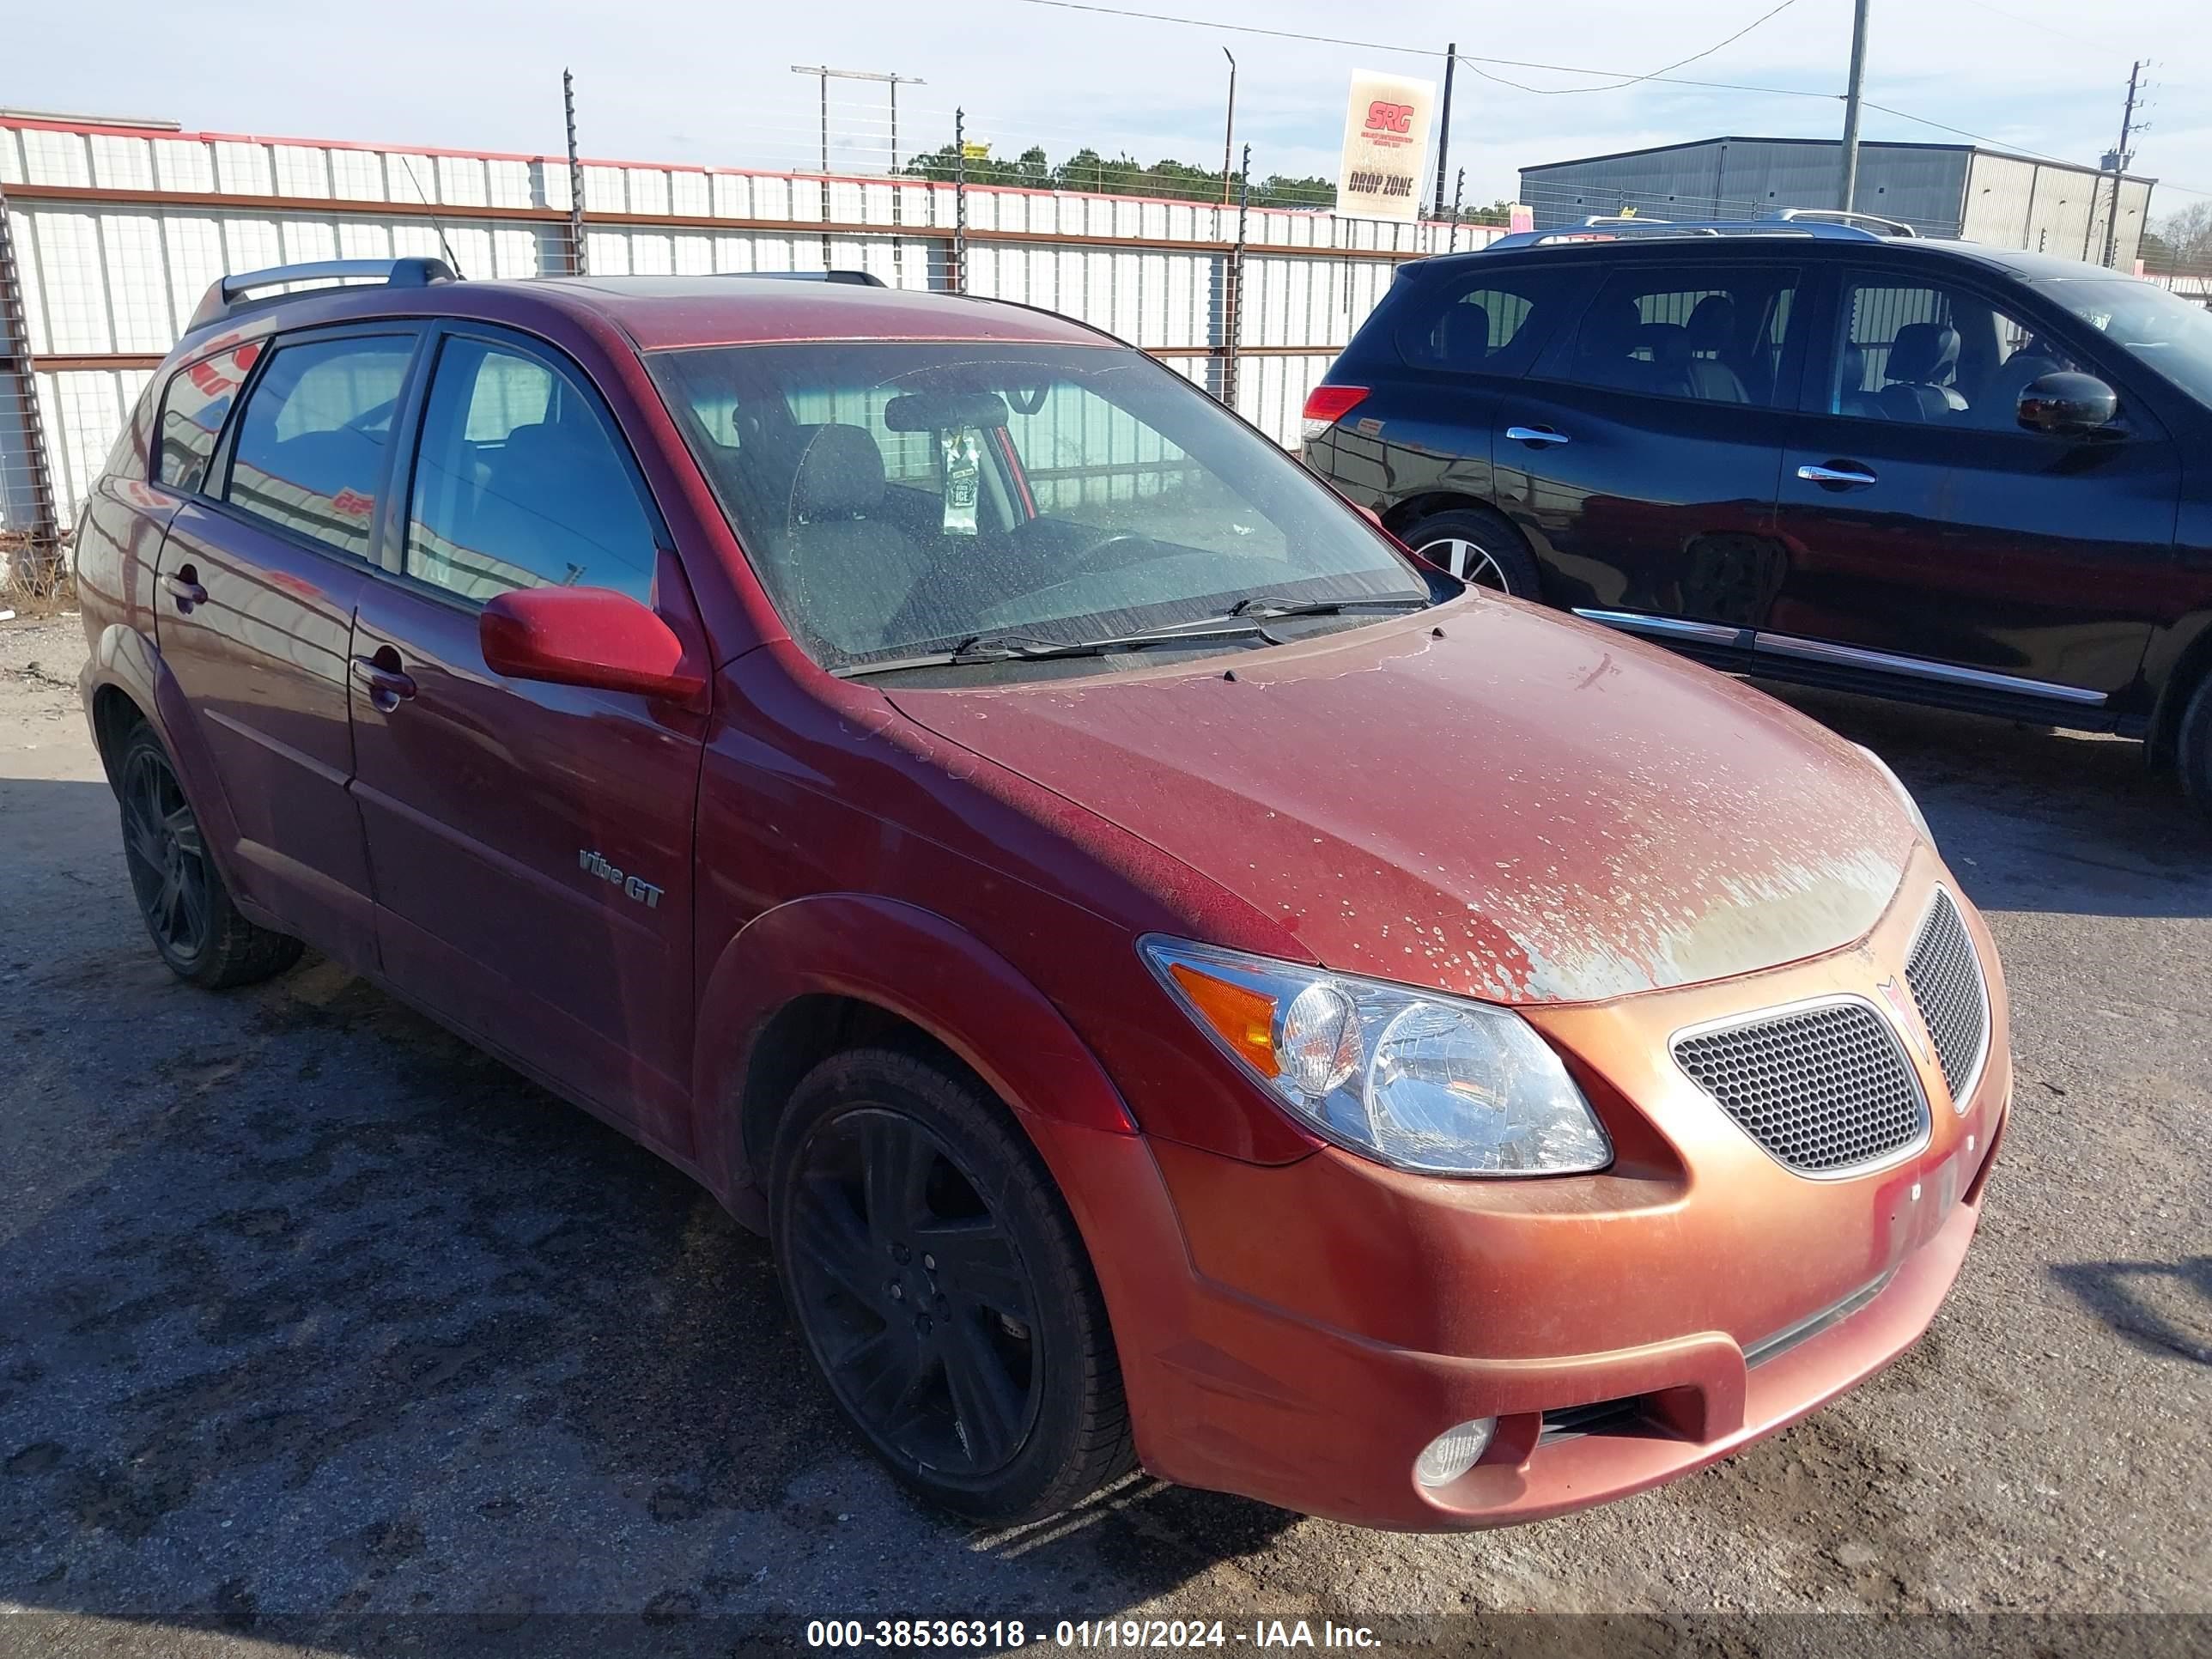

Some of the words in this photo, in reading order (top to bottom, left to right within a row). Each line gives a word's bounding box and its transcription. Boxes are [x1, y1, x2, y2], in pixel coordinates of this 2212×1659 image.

[1365, 101, 1414, 133] SRG
[1348, 171, 1383, 195] DROP
[1382, 174, 1413, 197] ZONE
[955, 490, 969, 502] ICE
[580, 849, 623, 884] vibe
[624, 876, 665, 908] GT
